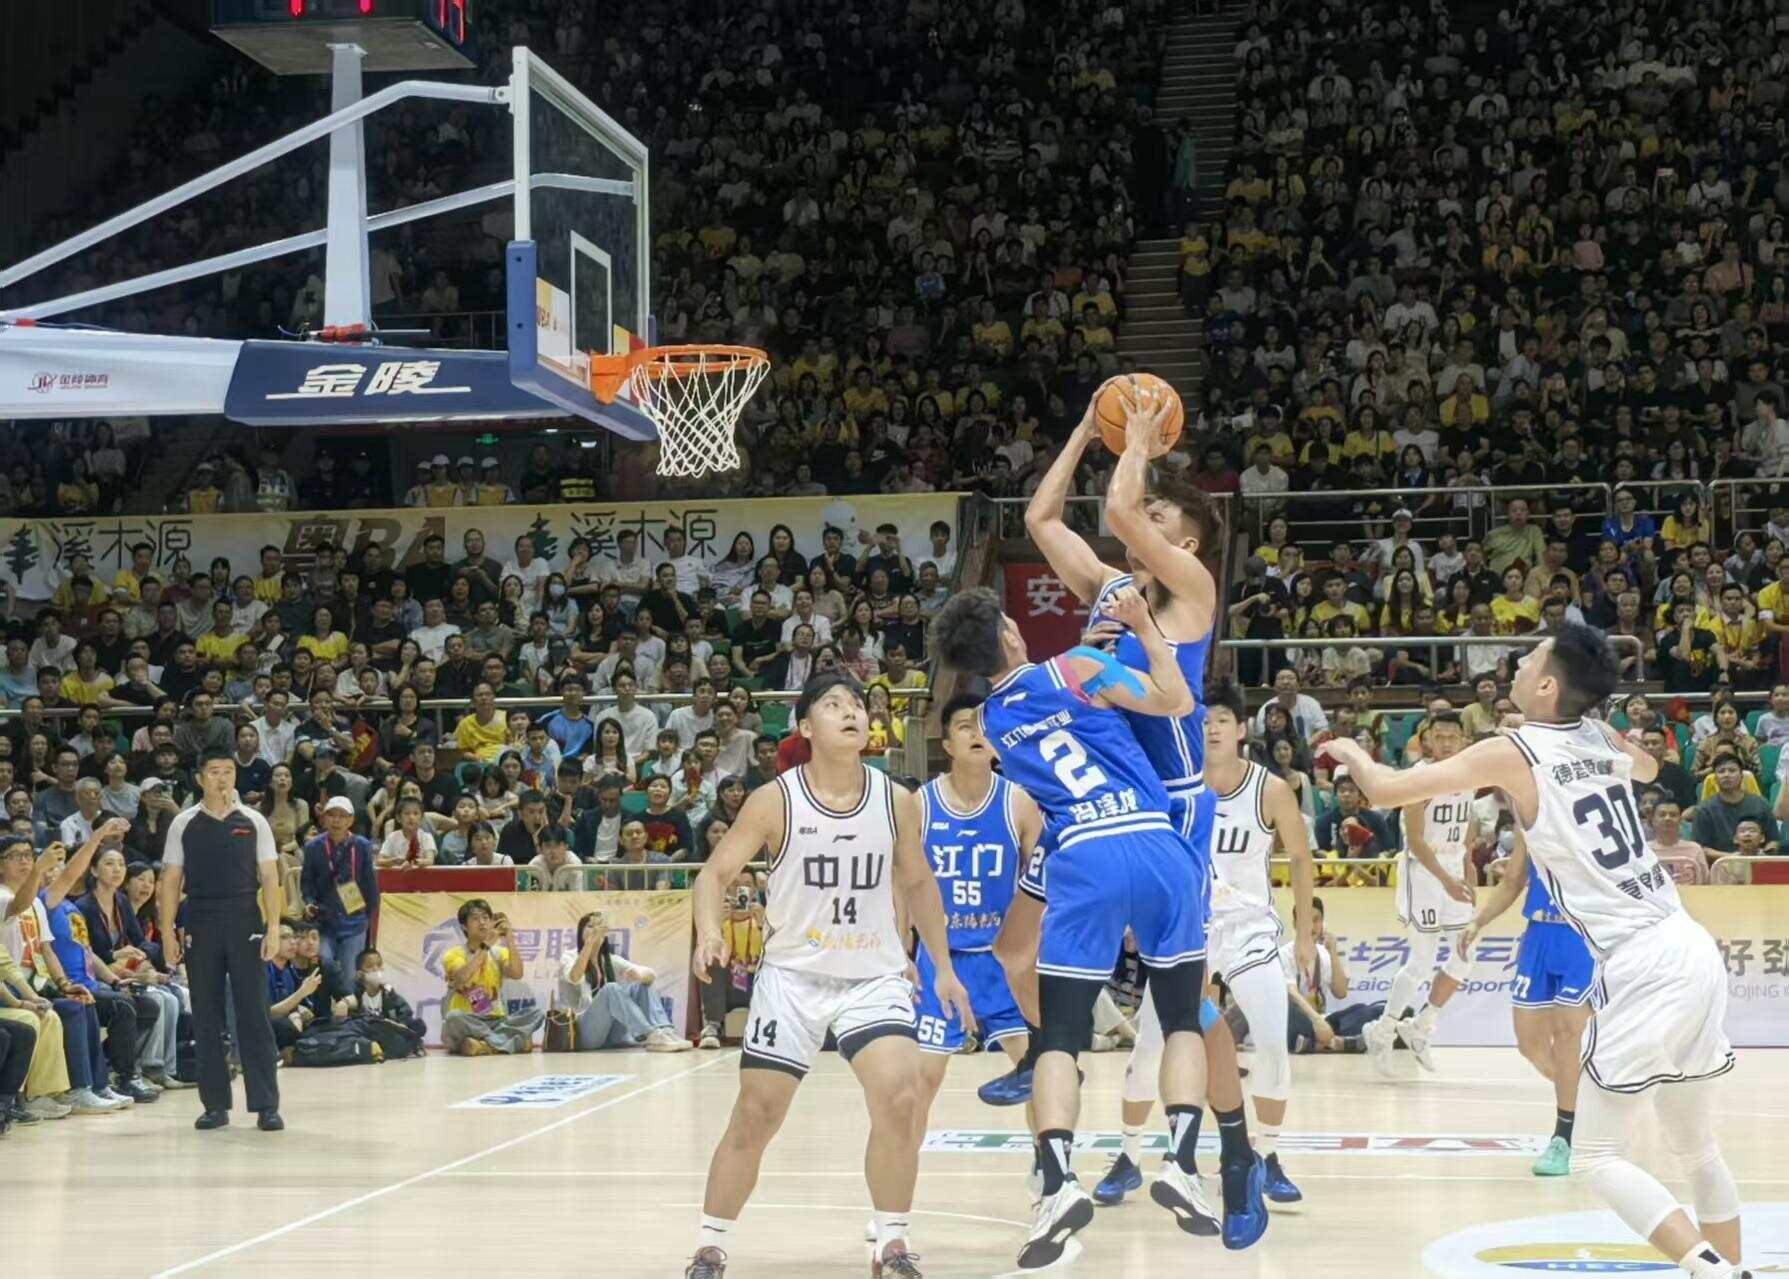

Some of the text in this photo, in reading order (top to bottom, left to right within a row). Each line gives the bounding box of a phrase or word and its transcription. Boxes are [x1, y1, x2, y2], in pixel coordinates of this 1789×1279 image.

[266, 360, 471, 399] 金陵
[50, 519, 193, 571] 溪木源
[570, 508, 718, 560] 溪木源
[1026, 574, 1091, 617] 安
[1039, 728, 1108, 799] 2
[1446, 826, 1461, 842] 10
[1573, 783, 1644, 870] 30
[803, 852, 885, 890] 中山
[931, 843, 1004, 878] 江门
[832, 896, 857, 925] 14
[952, 880, 982, 906] 55
[1421, 908, 1437, 925] 10
[751, 1016, 778, 1048] 14
[917, 1014, 948, 1046] 55
